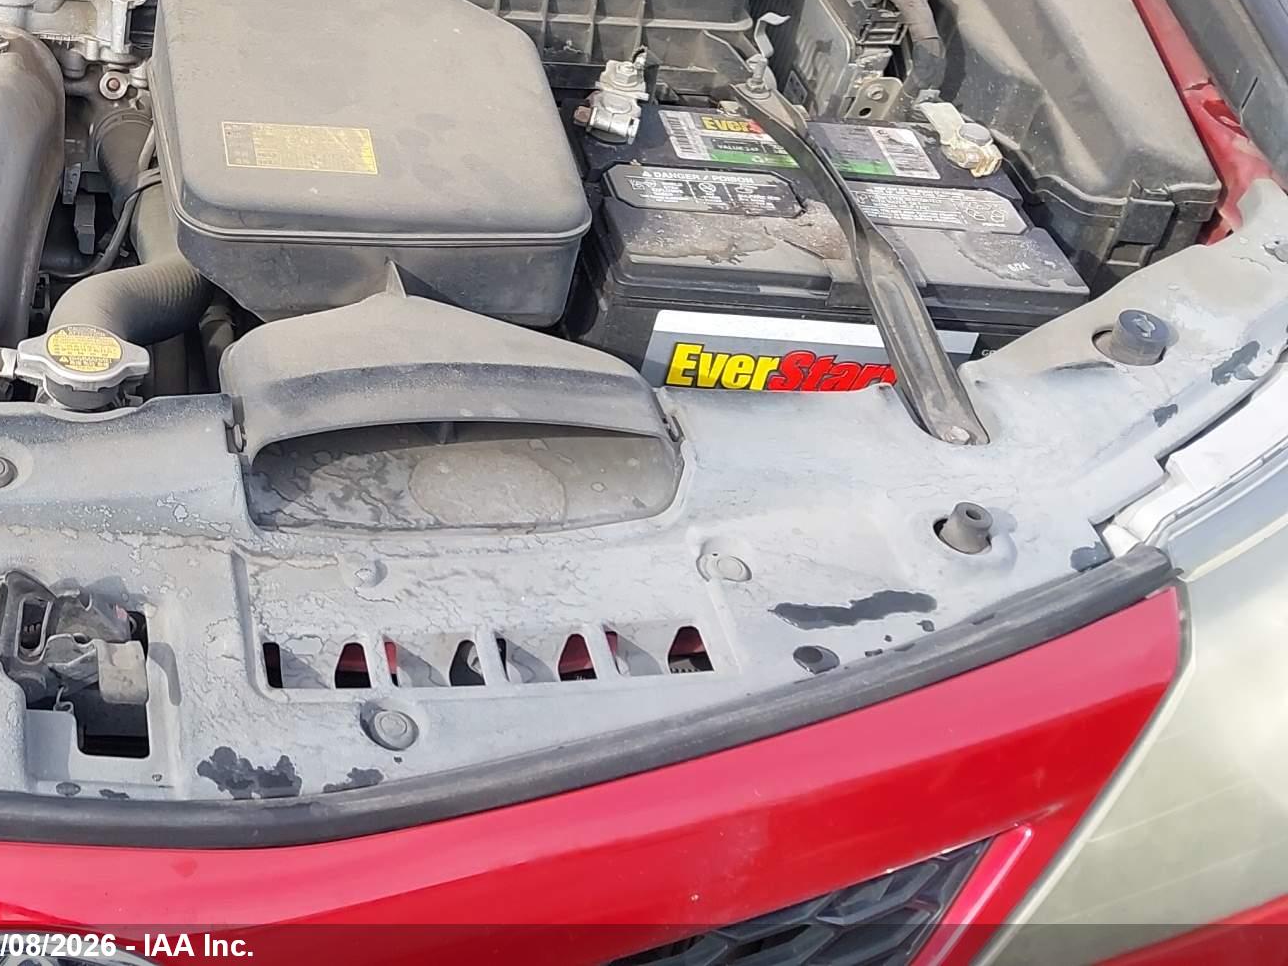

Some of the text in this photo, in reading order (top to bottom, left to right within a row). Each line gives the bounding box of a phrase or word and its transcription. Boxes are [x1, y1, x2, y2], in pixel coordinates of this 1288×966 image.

[701, 117, 762, 134] EverS
[653, 171, 702, 181] DANGER
[711, 174, 754, 183] POISON
[665, 341, 897, 392] EverStar
